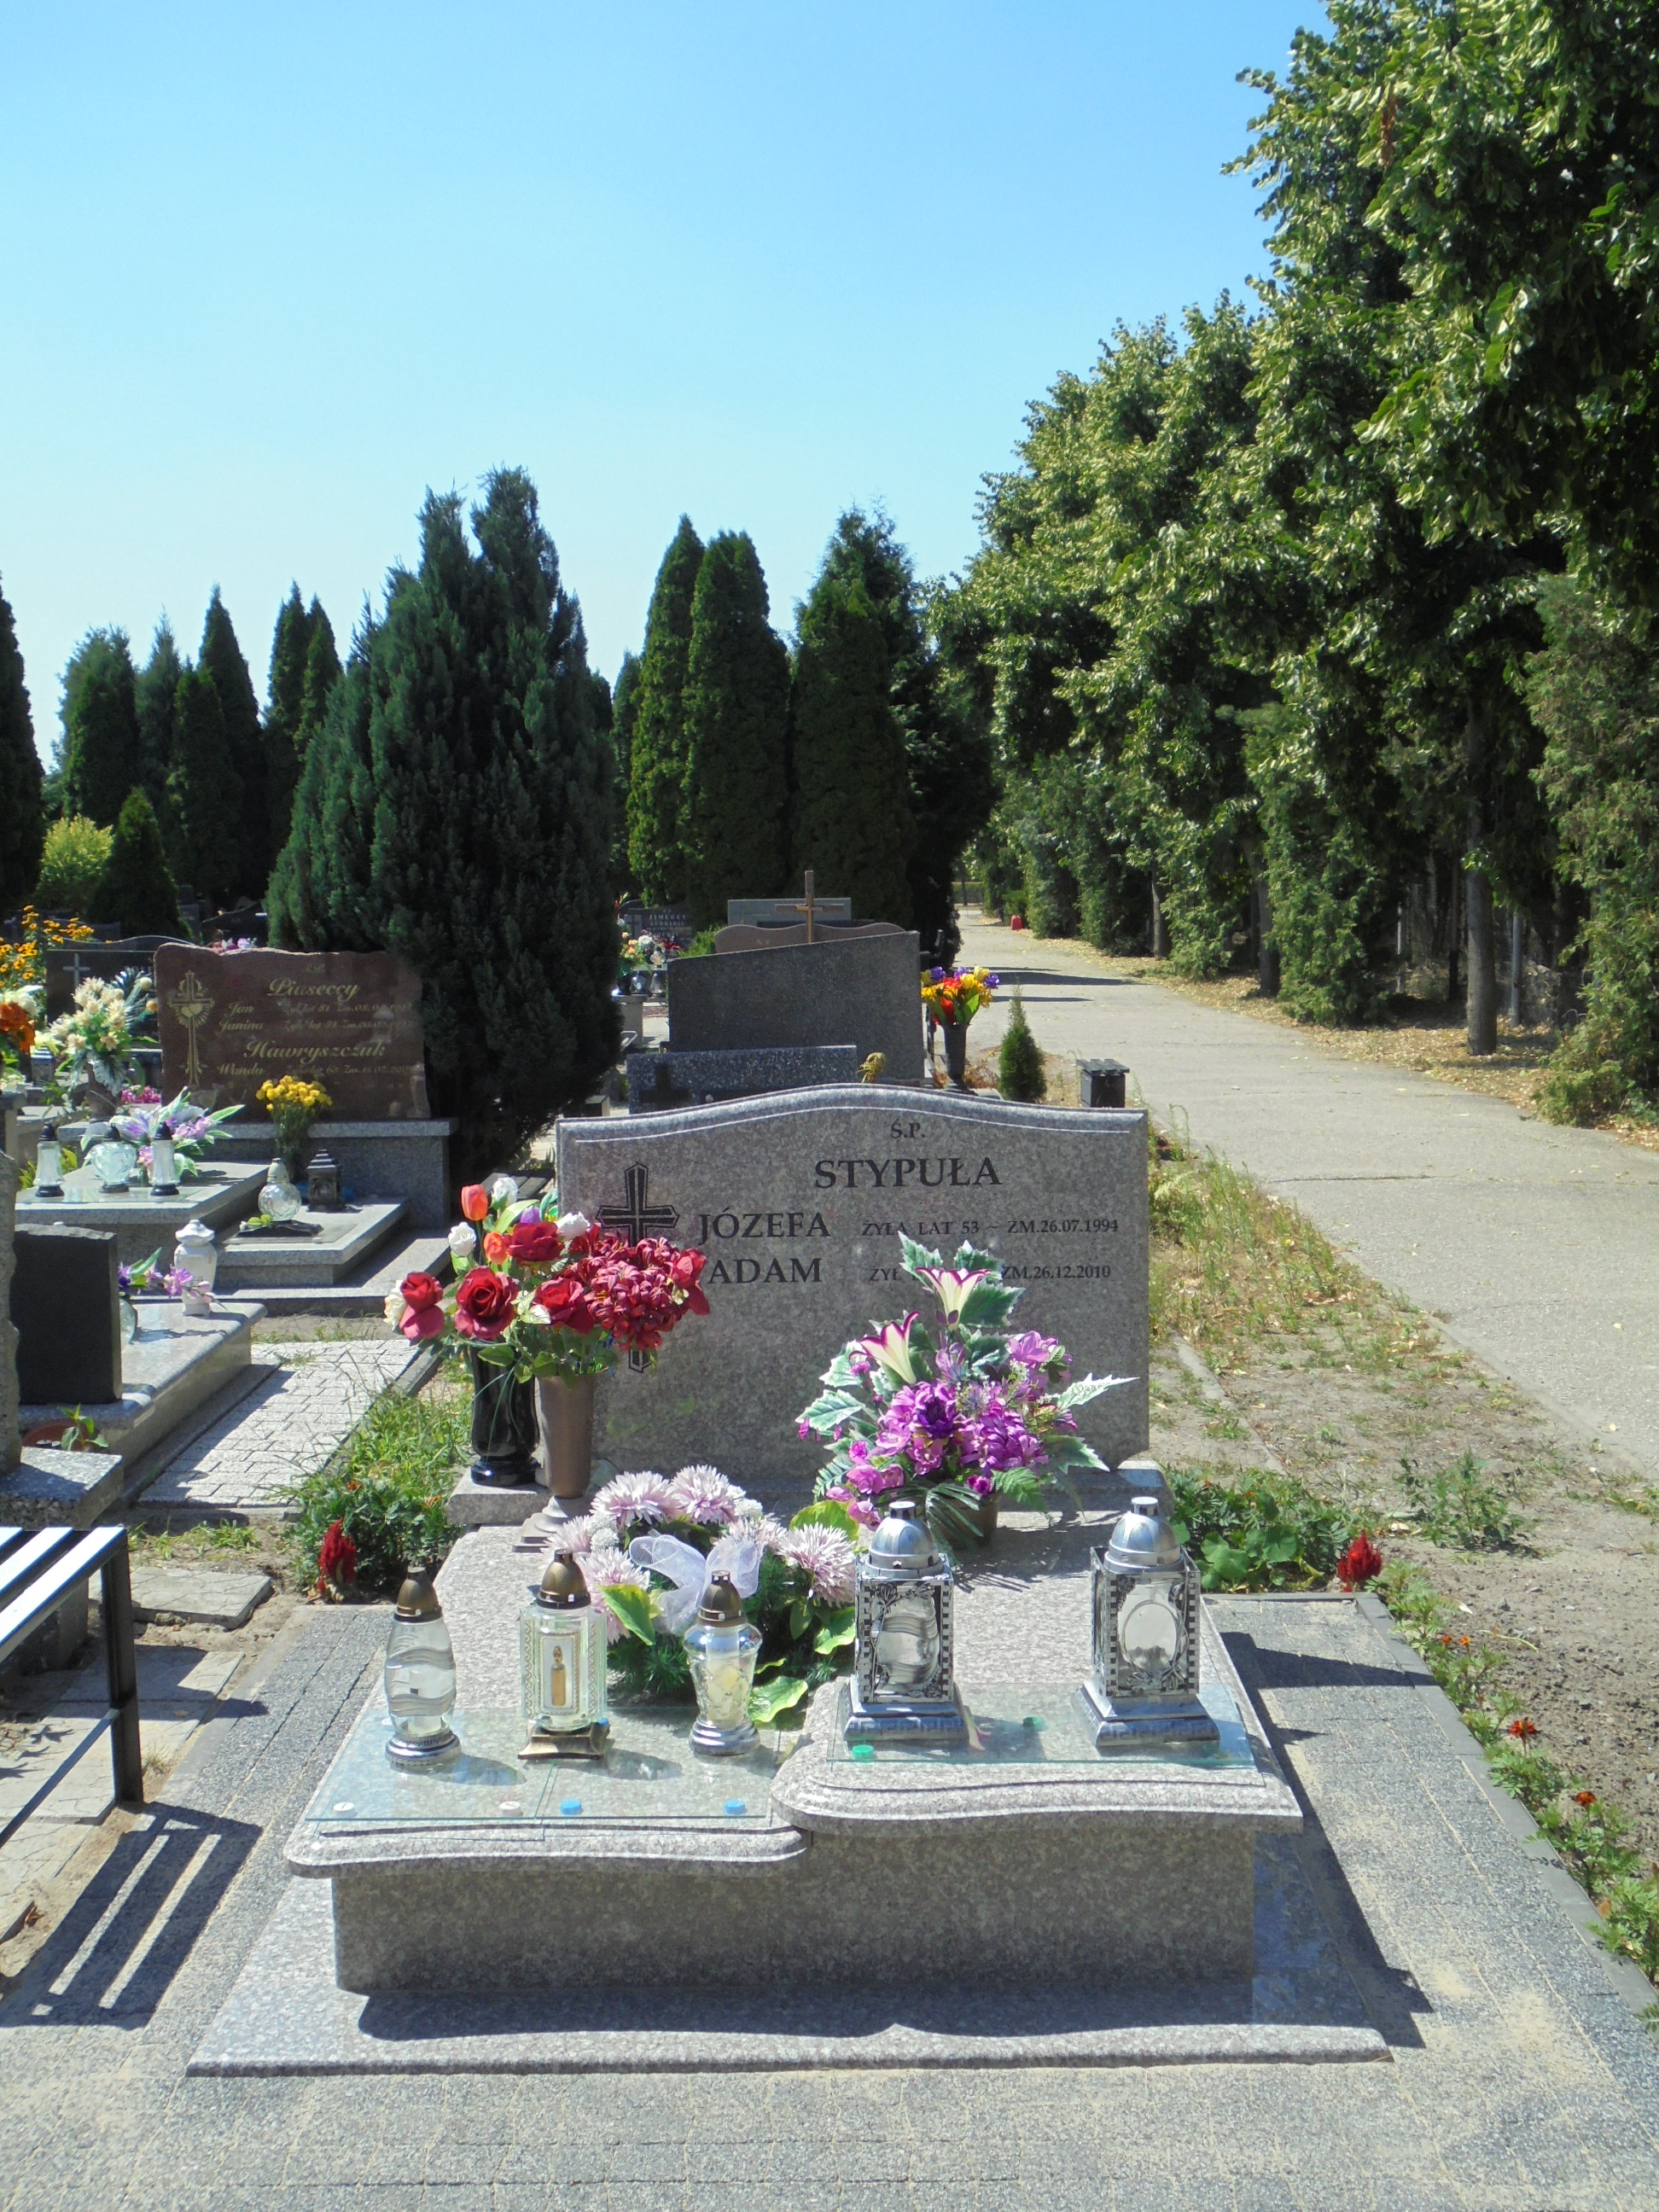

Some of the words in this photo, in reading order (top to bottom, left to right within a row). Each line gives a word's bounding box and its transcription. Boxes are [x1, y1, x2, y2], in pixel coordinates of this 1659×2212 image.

[267, 978, 359, 1001] Piaseccy
[224, 1000, 254, 1017] Jan
[217, 1019, 264, 1035] Janina
[243, 1039, 386, 1064] Hawryszczuk
[218, 1062, 265, 1075] Wanda
[890, 1118, 926, 1139] Ś.P.
[814, 1156, 1003, 1189] STYPUŁA
[697, 1206, 832, 1246] JÓZEFA
[918, 1220, 953, 1235] LAT
[962, 1220, 980, 1235] 53
[1007, 1219, 1120, 1234] ZM.26.07.1994
[707, 1258, 823, 1285] ADAM
